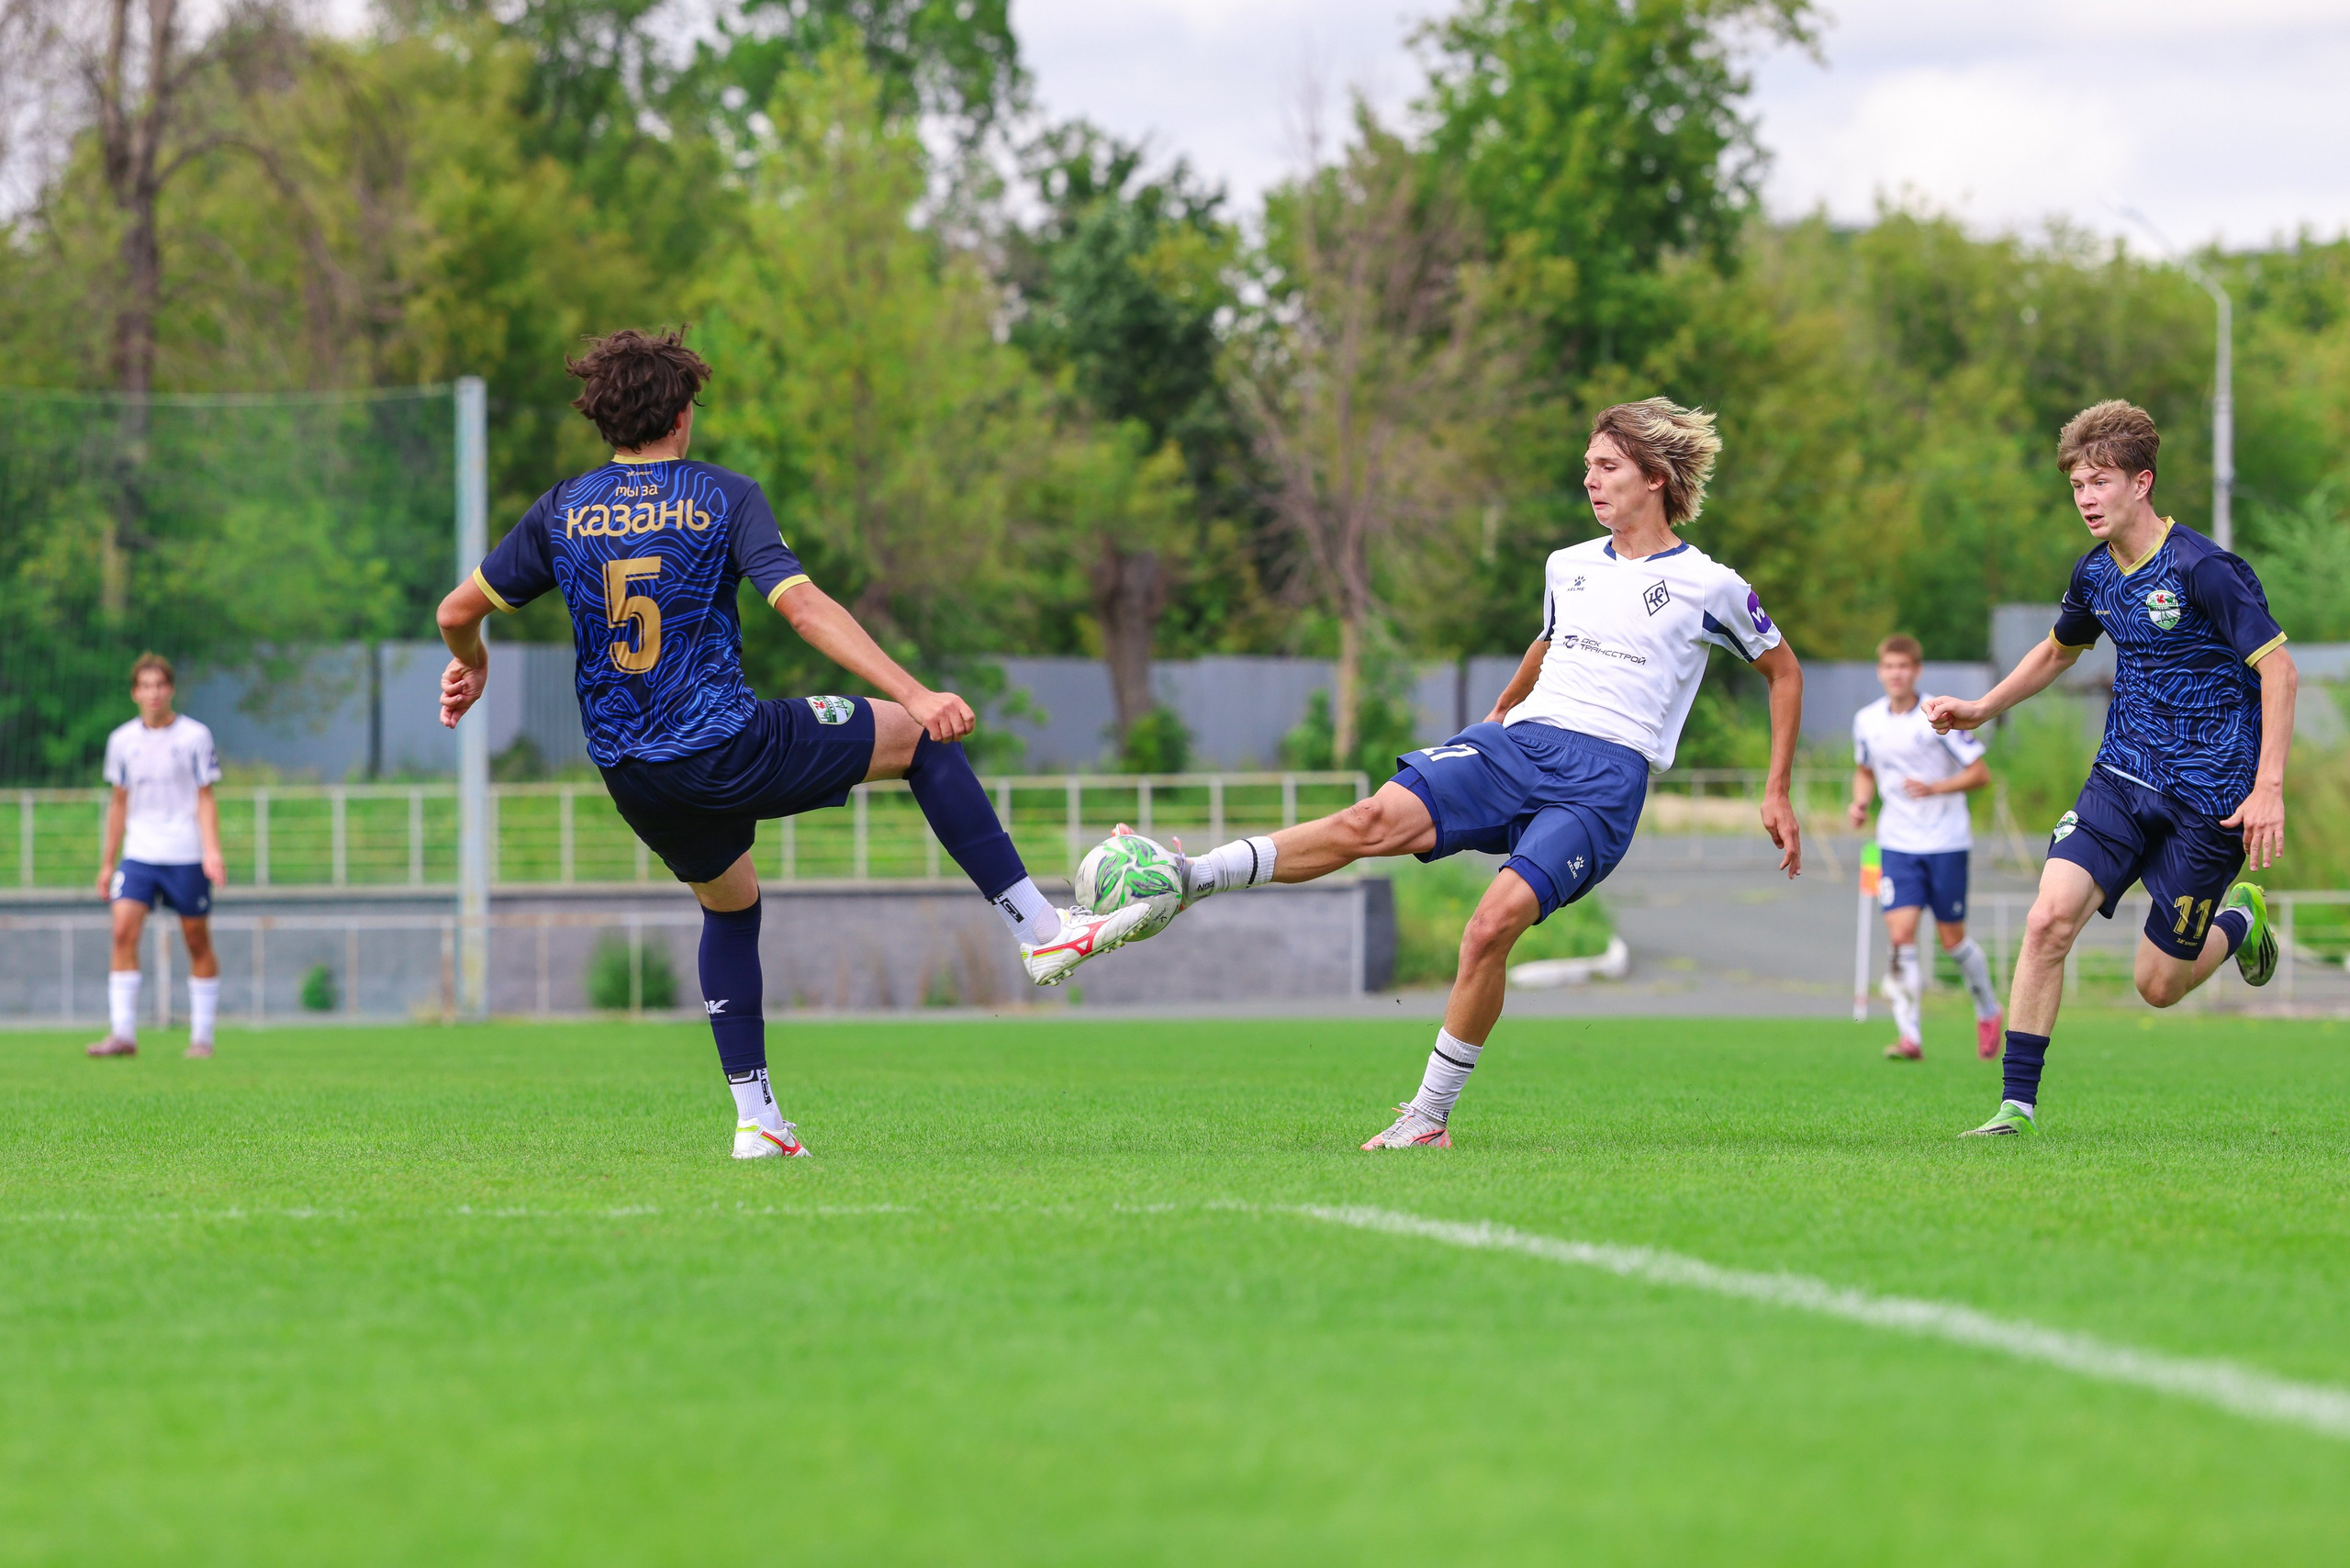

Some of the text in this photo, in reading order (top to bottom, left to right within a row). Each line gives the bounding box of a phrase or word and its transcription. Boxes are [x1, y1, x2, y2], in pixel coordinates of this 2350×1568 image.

[602, 555, 662, 674] 5
[1580, 644, 1646, 666] ТРАНССТРОЙ
[2173, 895, 2212, 939] 11
